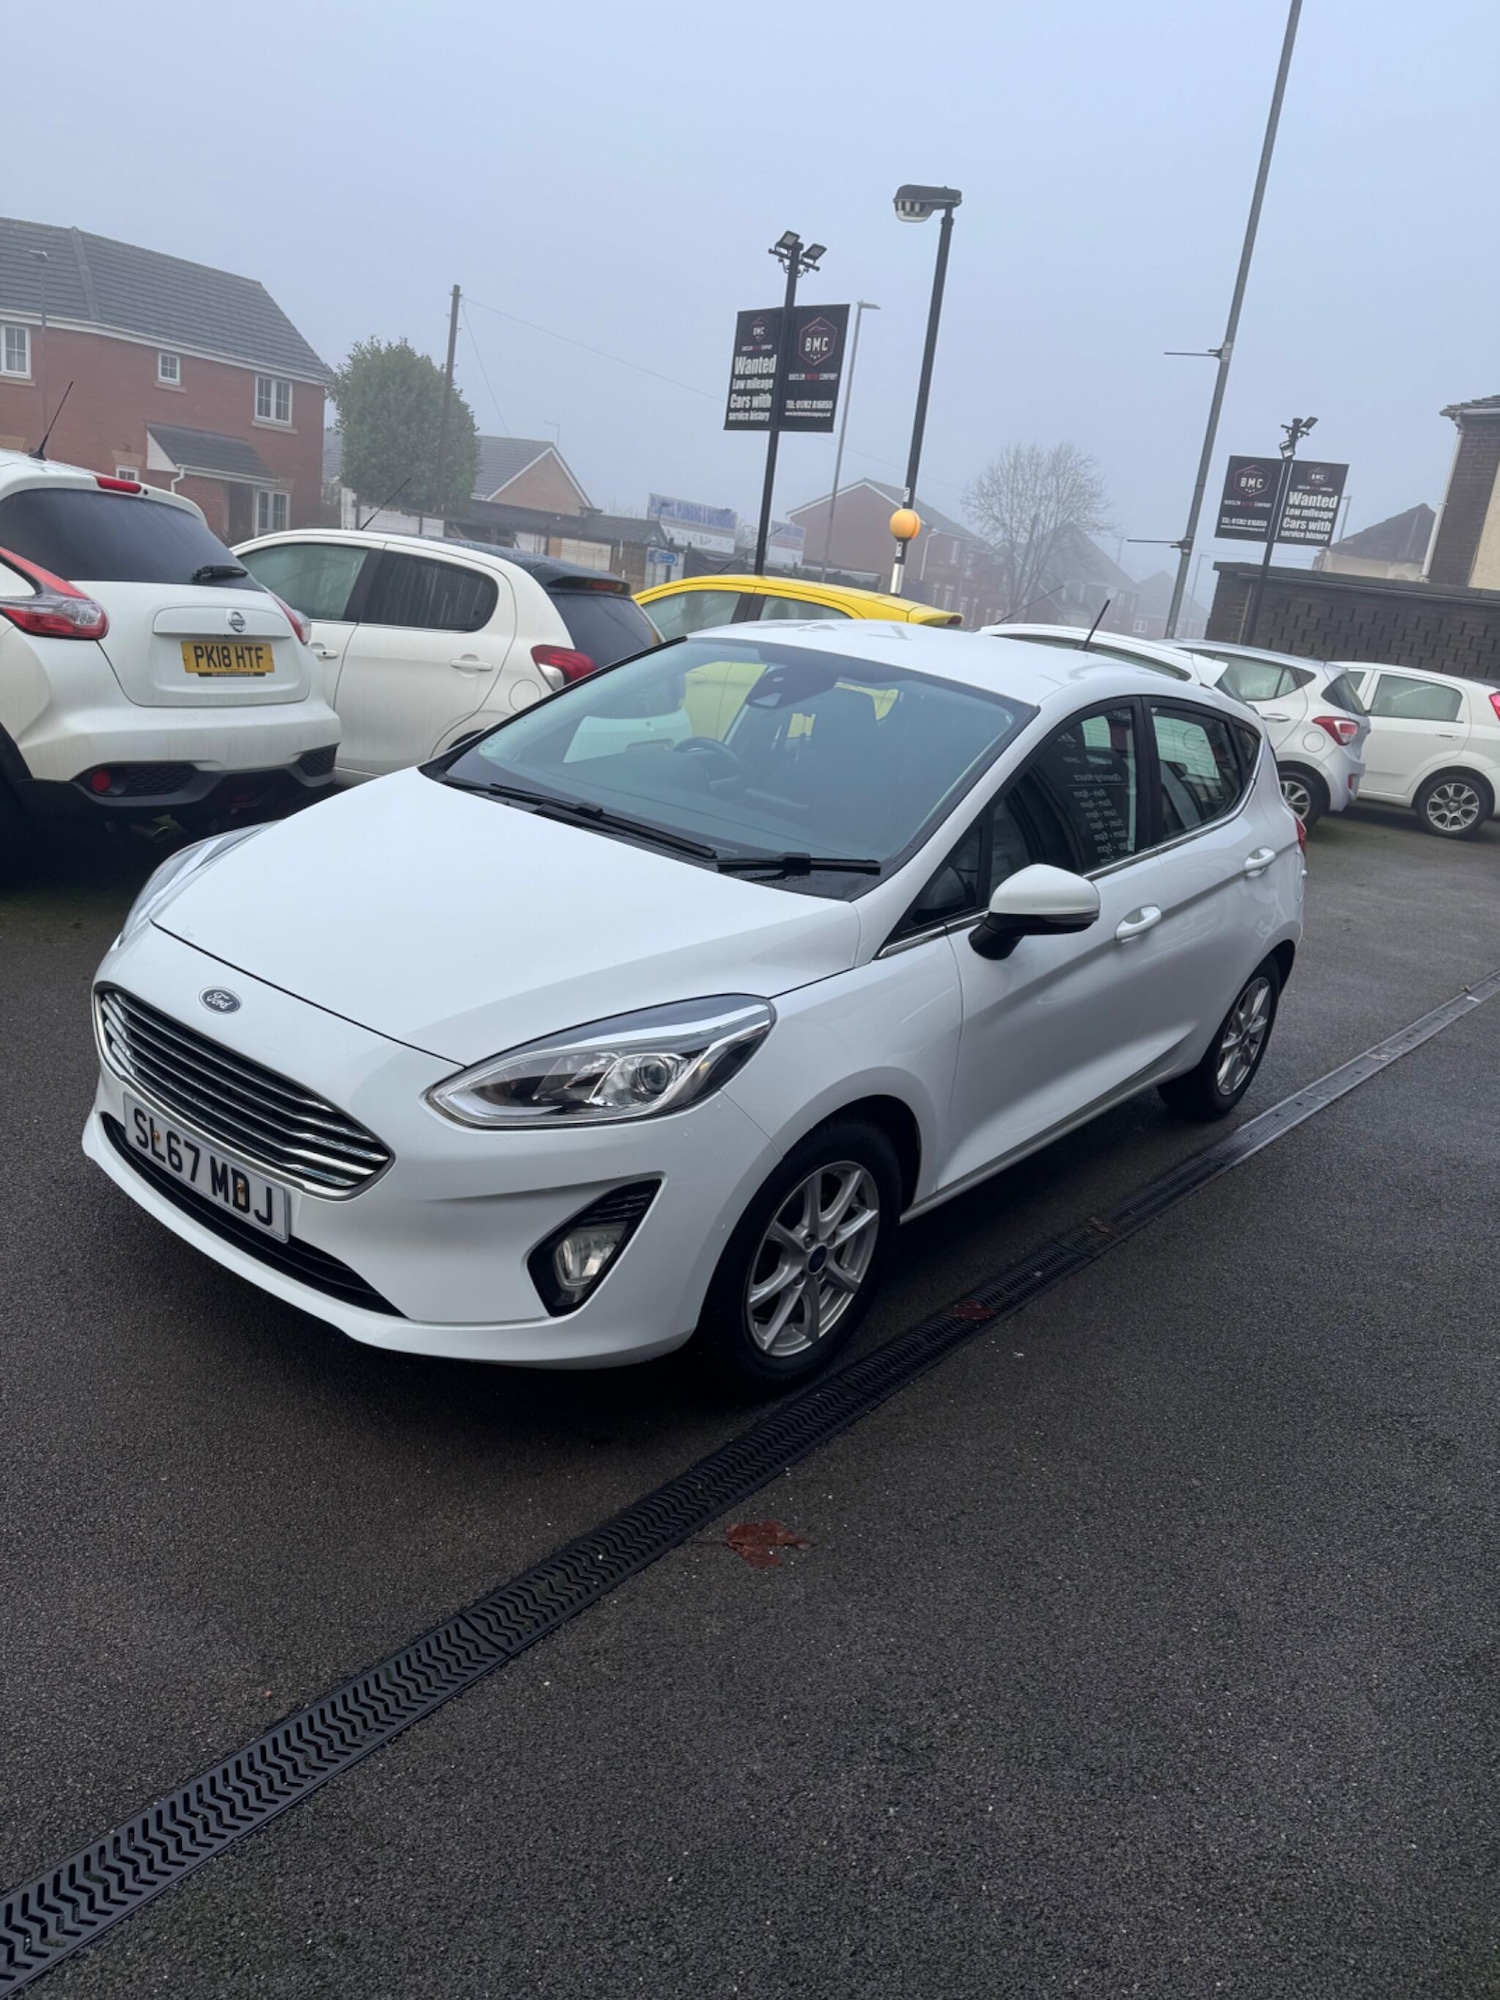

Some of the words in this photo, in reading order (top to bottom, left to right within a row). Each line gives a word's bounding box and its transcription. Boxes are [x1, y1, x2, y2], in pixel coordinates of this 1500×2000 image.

[804, 337, 829, 352] BMC
[734, 354, 778, 375] Wanted
[732, 378, 745, 390] Low
[746, 377, 774, 390] mileage
[730, 393, 751, 409] Cars
[751, 393, 772, 409] with
[1240, 477, 1263, 489] BMC
[1288, 491, 1338, 509] Wanted
[1285, 506, 1301, 516] Low
[1301, 507, 1334, 520] mileage
[1282, 517, 1307, 529] Cars
[1308, 518, 1331, 532] with
[193, 645, 232, 668] PK18
[235, 645, 264, 668] HTF
[206, 991, 233, 1010] Ford
[134, 1108, 200, 1183] SL67
[210, 1155, 272, 1227] MDJ
